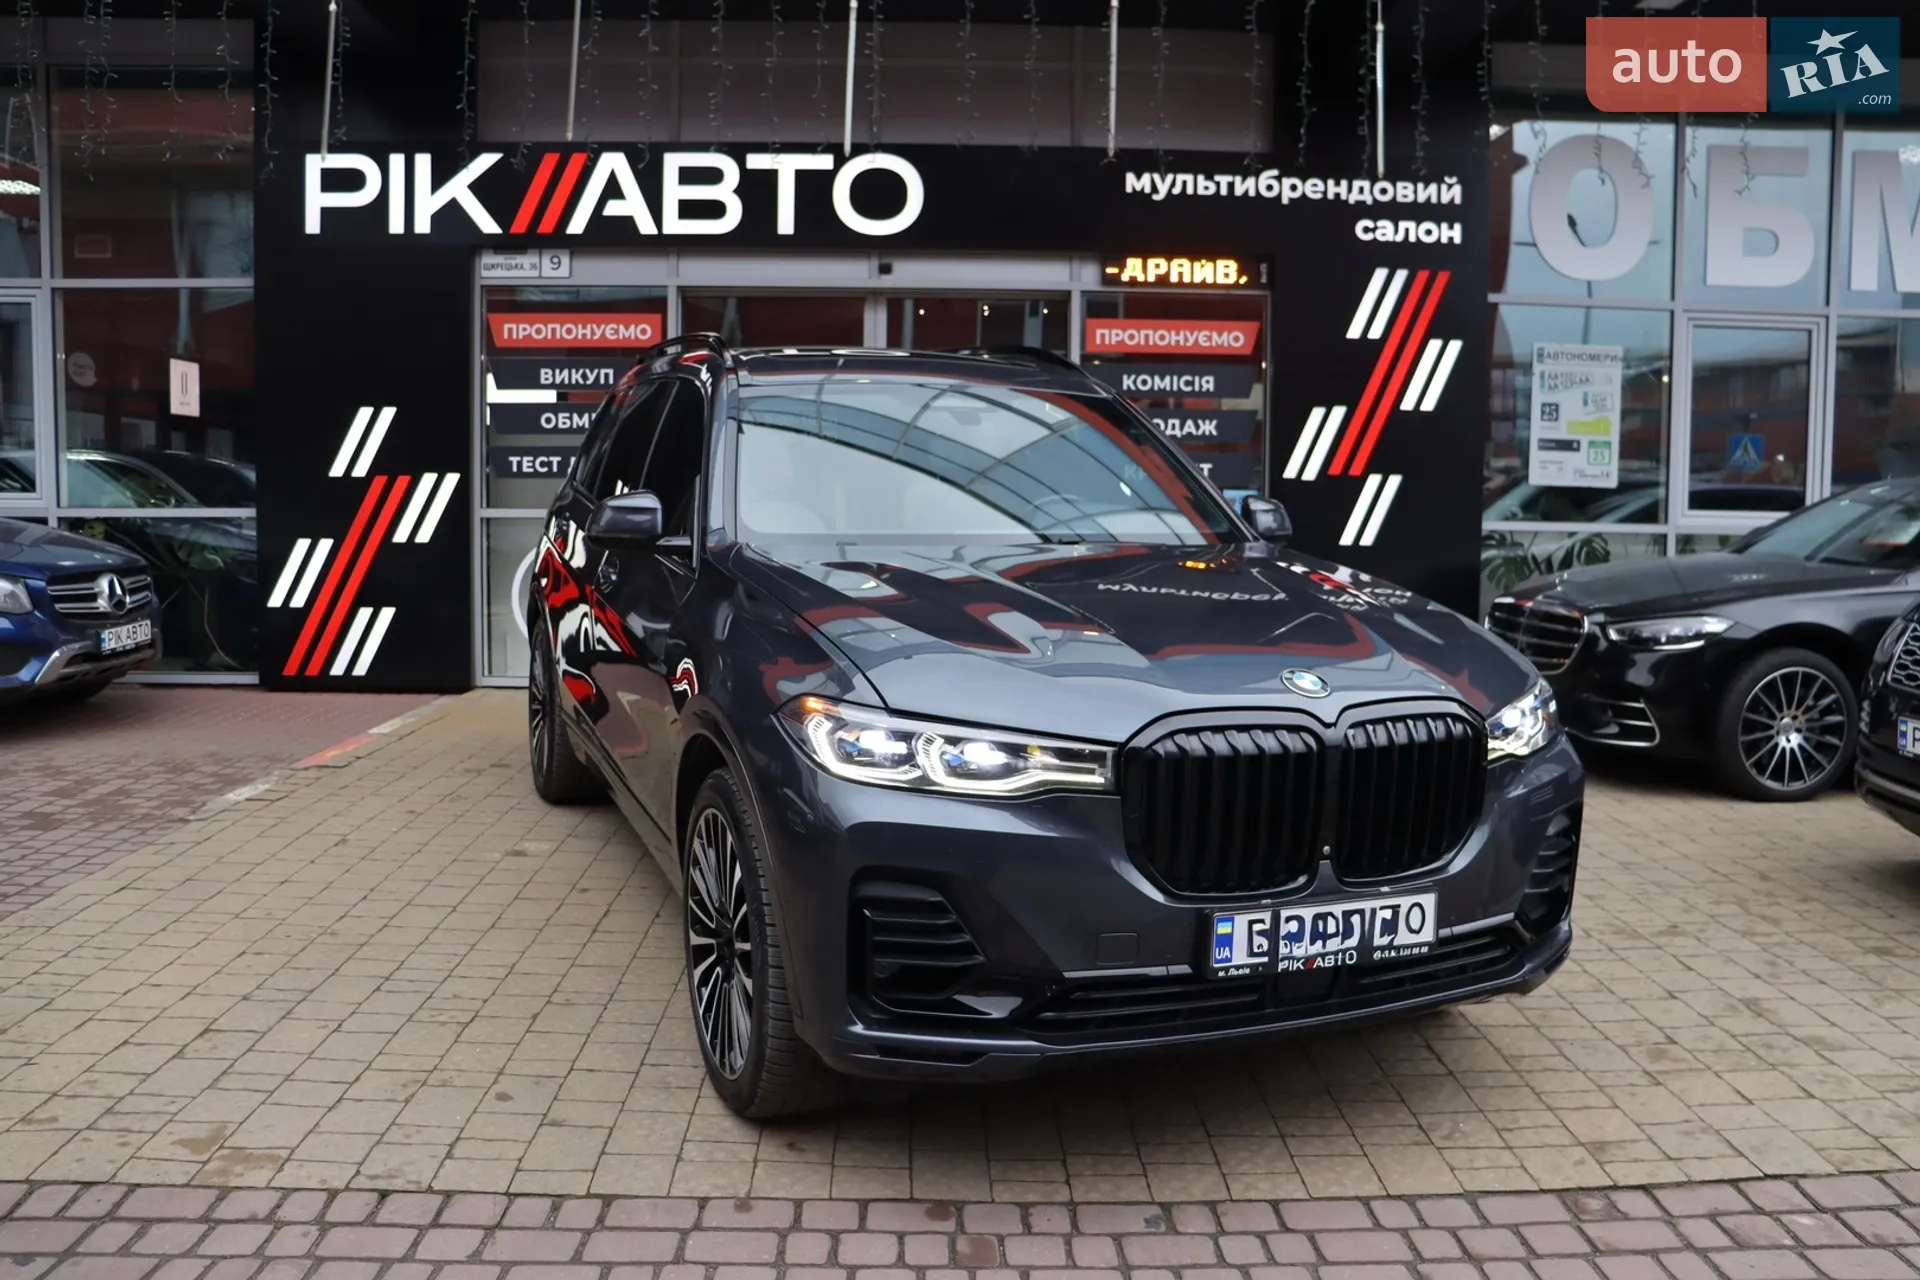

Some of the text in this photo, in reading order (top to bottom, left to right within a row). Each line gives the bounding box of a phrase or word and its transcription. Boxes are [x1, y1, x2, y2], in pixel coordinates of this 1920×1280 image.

[1125, 169, 1463, 205] мультибрендовий
[1355, 219, 1463, 244] салон
[550, 254, 562, 271] 9
[503, 323, 653, 340] ПРОПОНУЄМО
[1095, 329, 1245, 347] ПРОПОНУЄМО
[540, 368, 614, 385] ВИКУП
[1122, 374, 1215, 392] КОМІСІЯ
[540, 412, 596, 429] ОБМ
[1542, 404, 1557, 420] 25
[508, 456, 562, 473] ТЕСТ
[1215, 946, 1231, 959] UA
